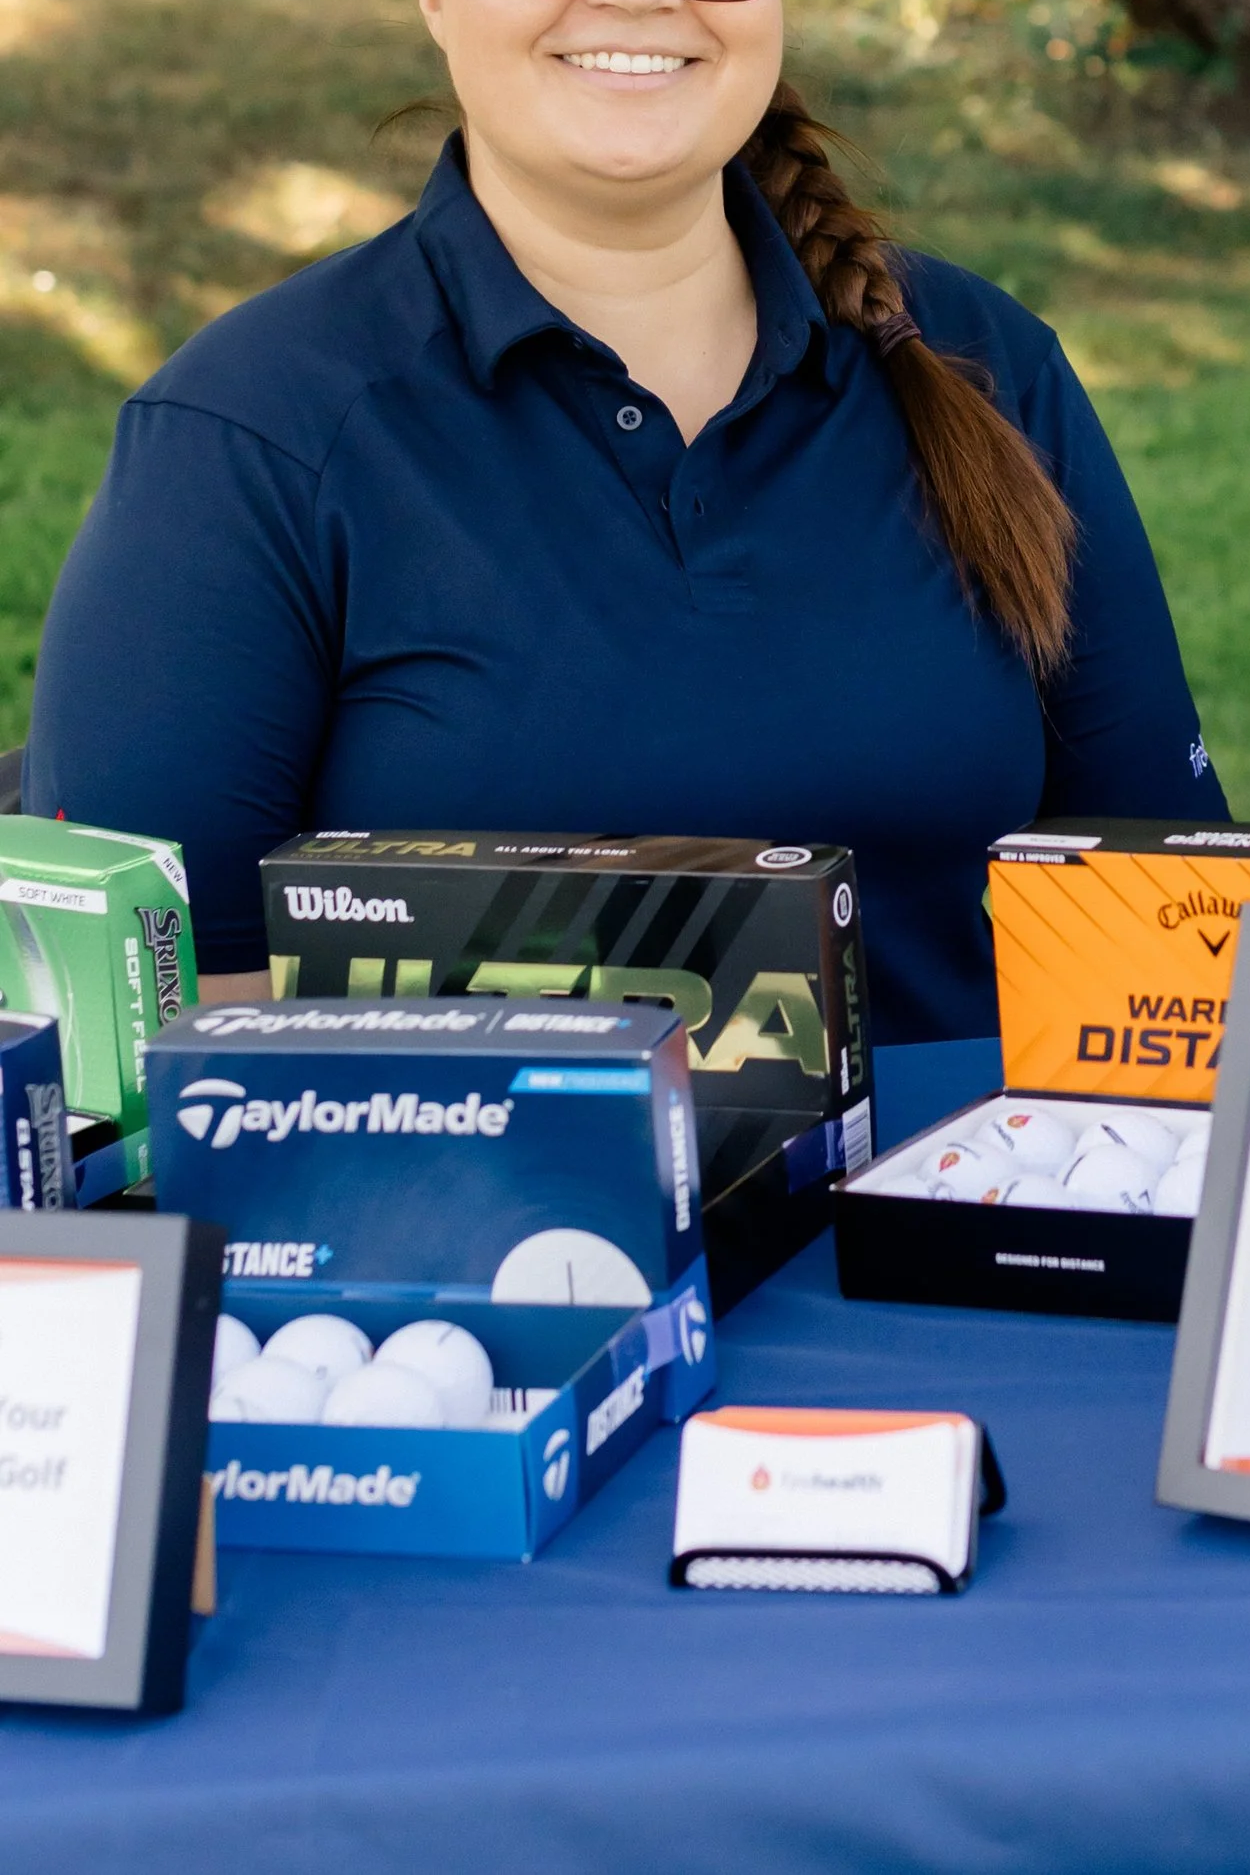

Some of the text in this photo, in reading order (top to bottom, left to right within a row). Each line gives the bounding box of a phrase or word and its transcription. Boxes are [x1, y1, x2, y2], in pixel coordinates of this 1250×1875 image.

[163, 858, 183, 882] NEW
[299, 840, 477, 857] ULTRA
[18, 886, 86, 908] SOFT WHITE
[284, 886, 408, 924] Wilson
[135, 907, 182, 1026] SRIXO
[124, 937, 147, 1093] SOFT FEEL
[843, 941, 864, 1086] ULTRA
[1077, 1023, 1223, 1070] DIST
[177, 1078, 509, 1149] TaylorMade
[25, 1082, 66, 1212] SRIXO
[207, 1459, 415, 1508] ylorMade
